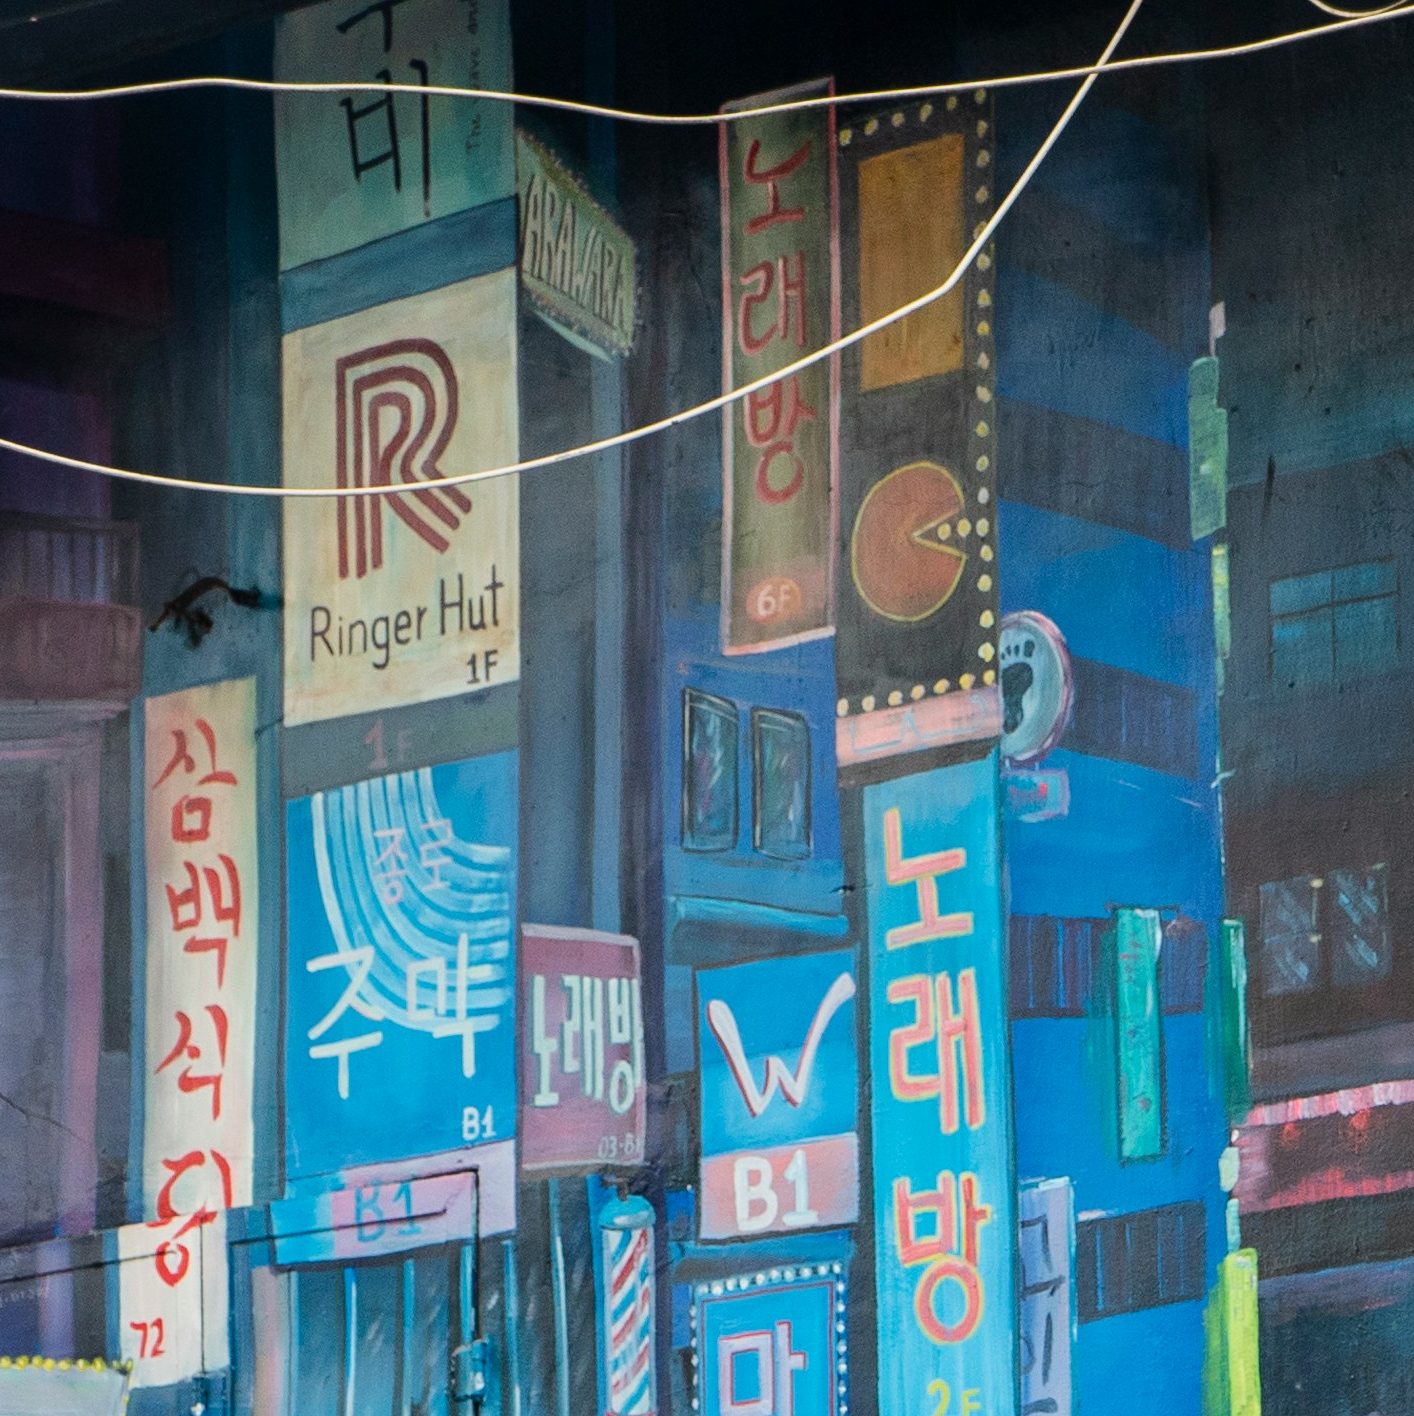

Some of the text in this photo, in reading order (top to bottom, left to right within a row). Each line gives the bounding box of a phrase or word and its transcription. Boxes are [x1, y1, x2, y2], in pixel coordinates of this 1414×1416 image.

[738, 138, 816, 505] 노래방
[336, 337, 472, 579] R
[310, 563, 505, 671] Ringer Hut
[466, 649, 499, 685] 1F
[755, 581, 793, 618] 6F
[152, 717, 241, 1288] 삼백식당
[306, 933, 501, 1100] 주막
[530, 974, 644, 1116] 노래방
[705, 972, 857, 1119] W
[461, 1104, 497, 1141] B1
[883, 807, 992, 1345] 노래방
[353, 1173, 423, 1243] B1
[733, 1147, 820, 1233] B1
